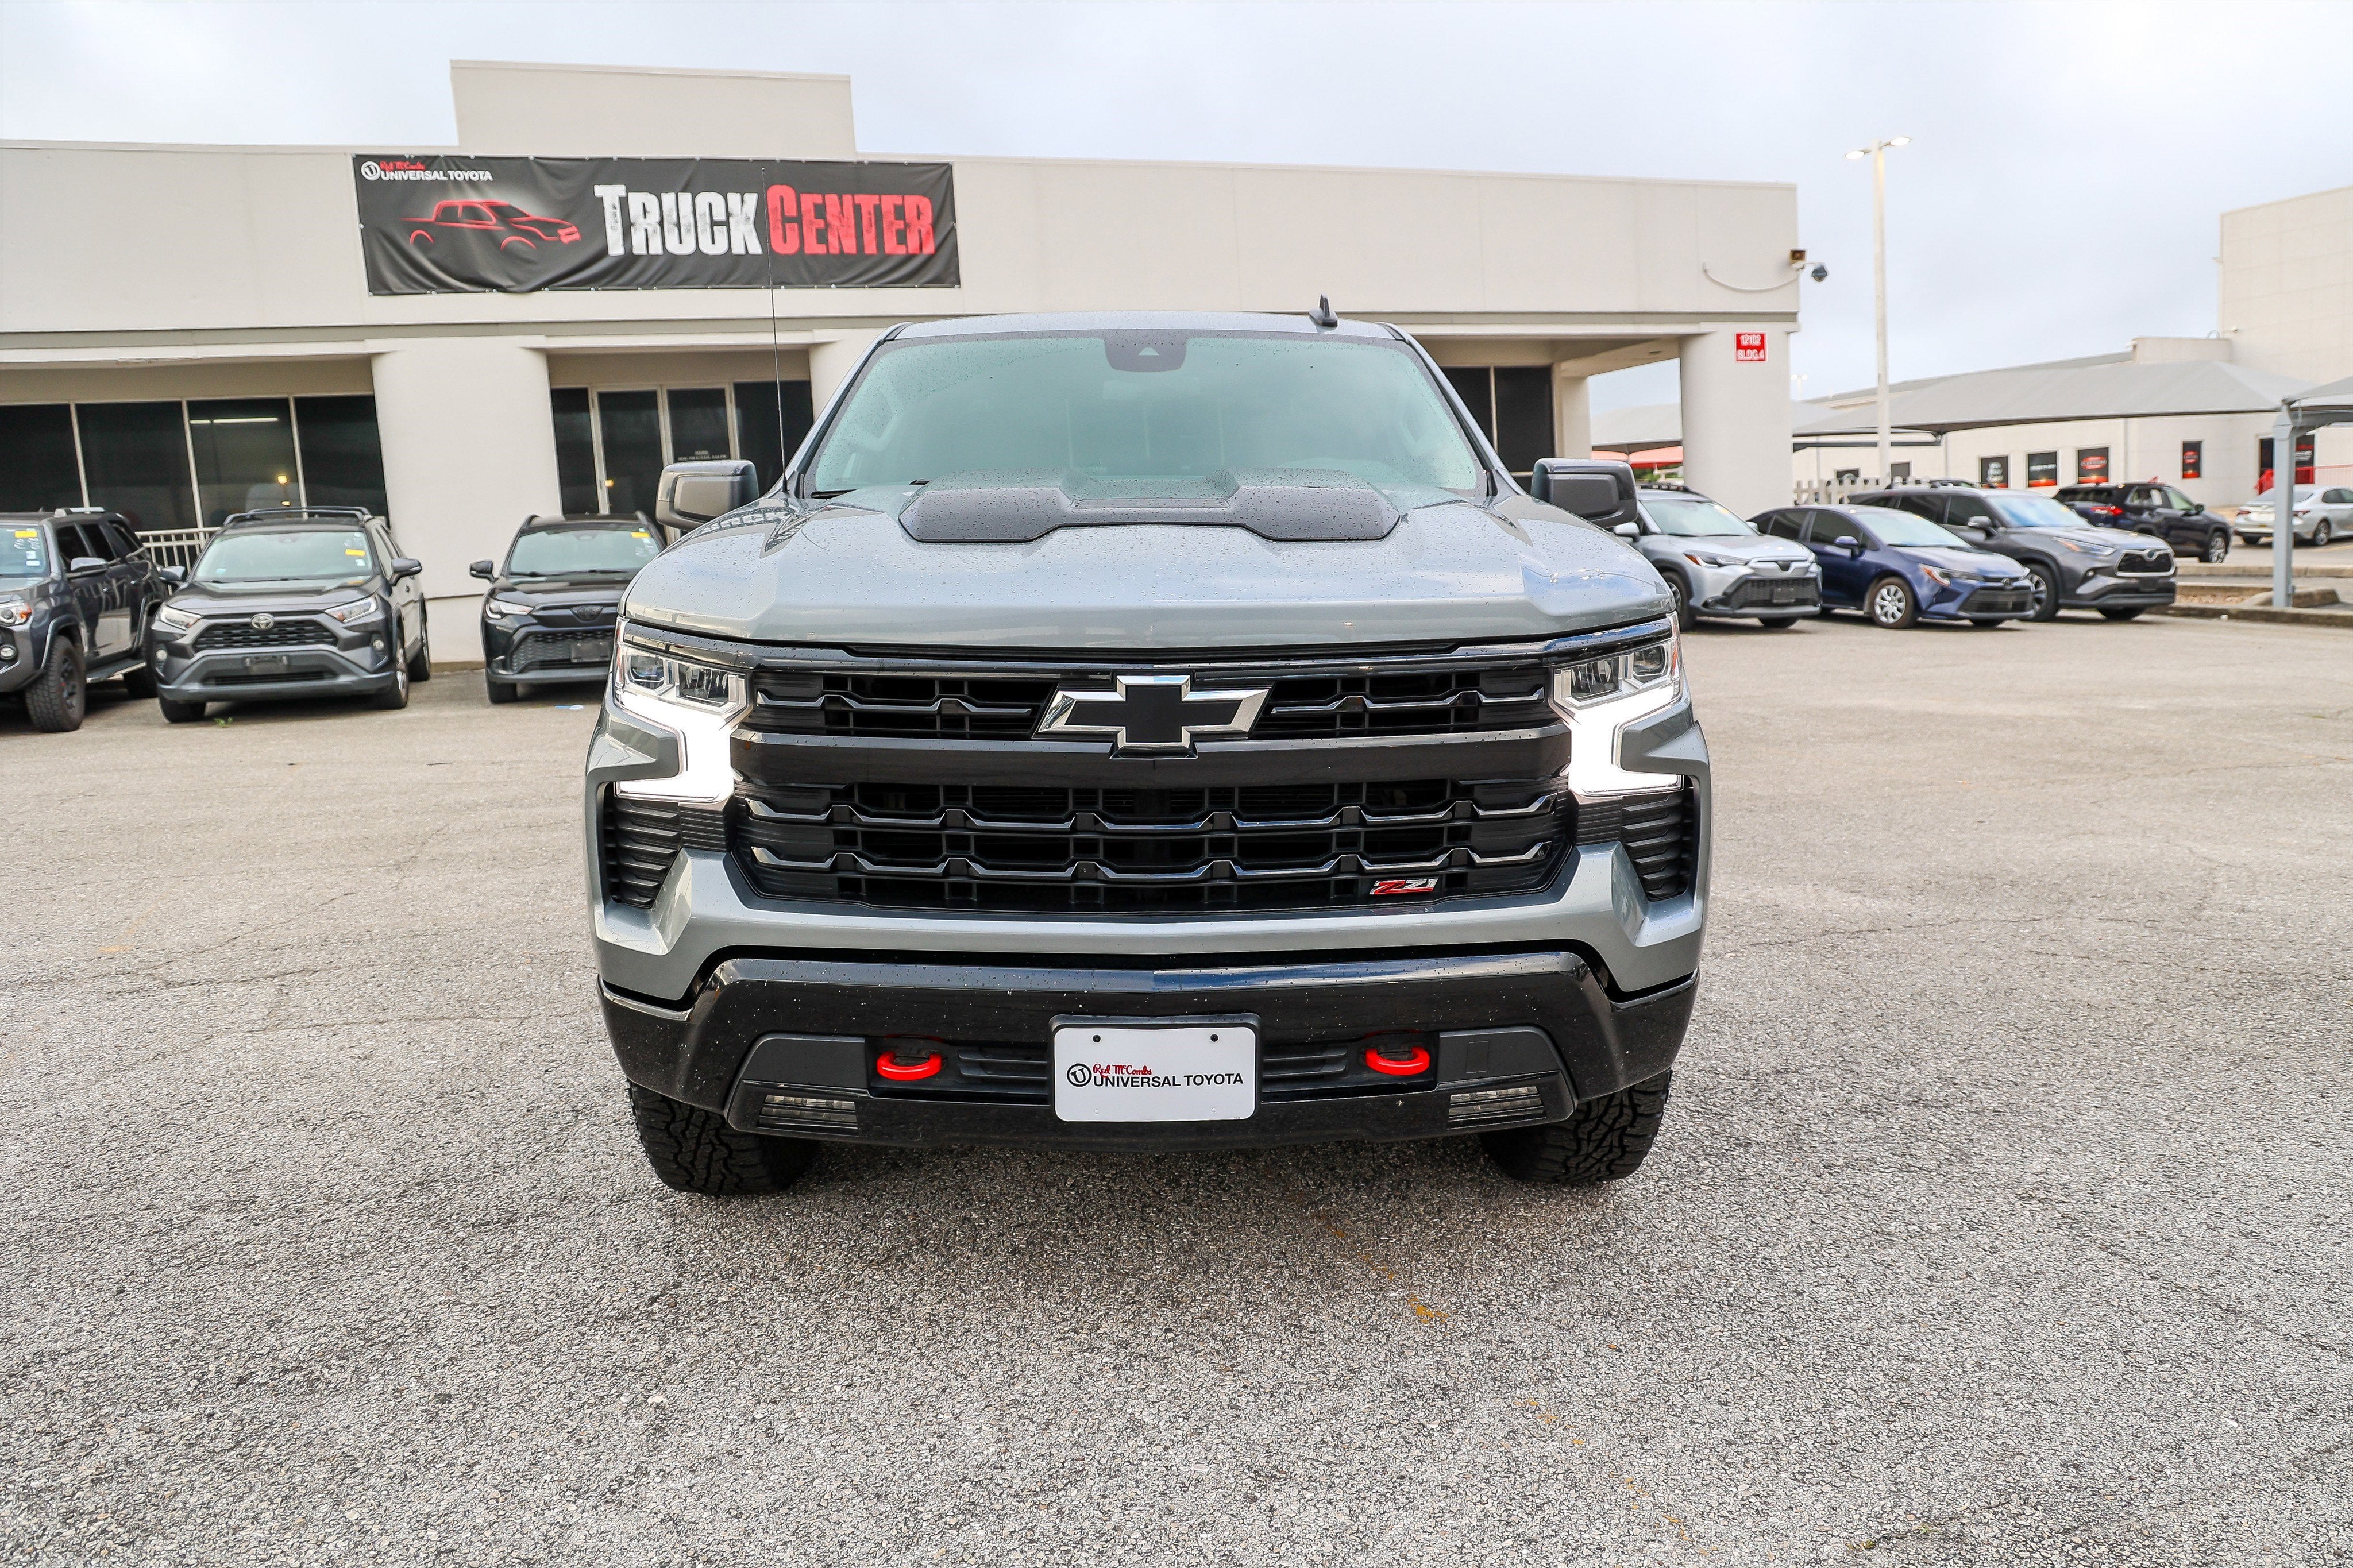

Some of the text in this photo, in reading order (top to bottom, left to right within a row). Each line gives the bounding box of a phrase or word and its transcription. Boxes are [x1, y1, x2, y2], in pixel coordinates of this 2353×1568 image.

[381, 170, 493, 181] UNIVERSAL TOYOTA
[594, 184, 934, 256] TRUCK CENTER
[1369, 878, 1438, 895] Z71
[1093, 1063, 1152, 1078] Red McCombs
[1094, 1073, 1244, 1087] UNIVERSAL TOYOTA
